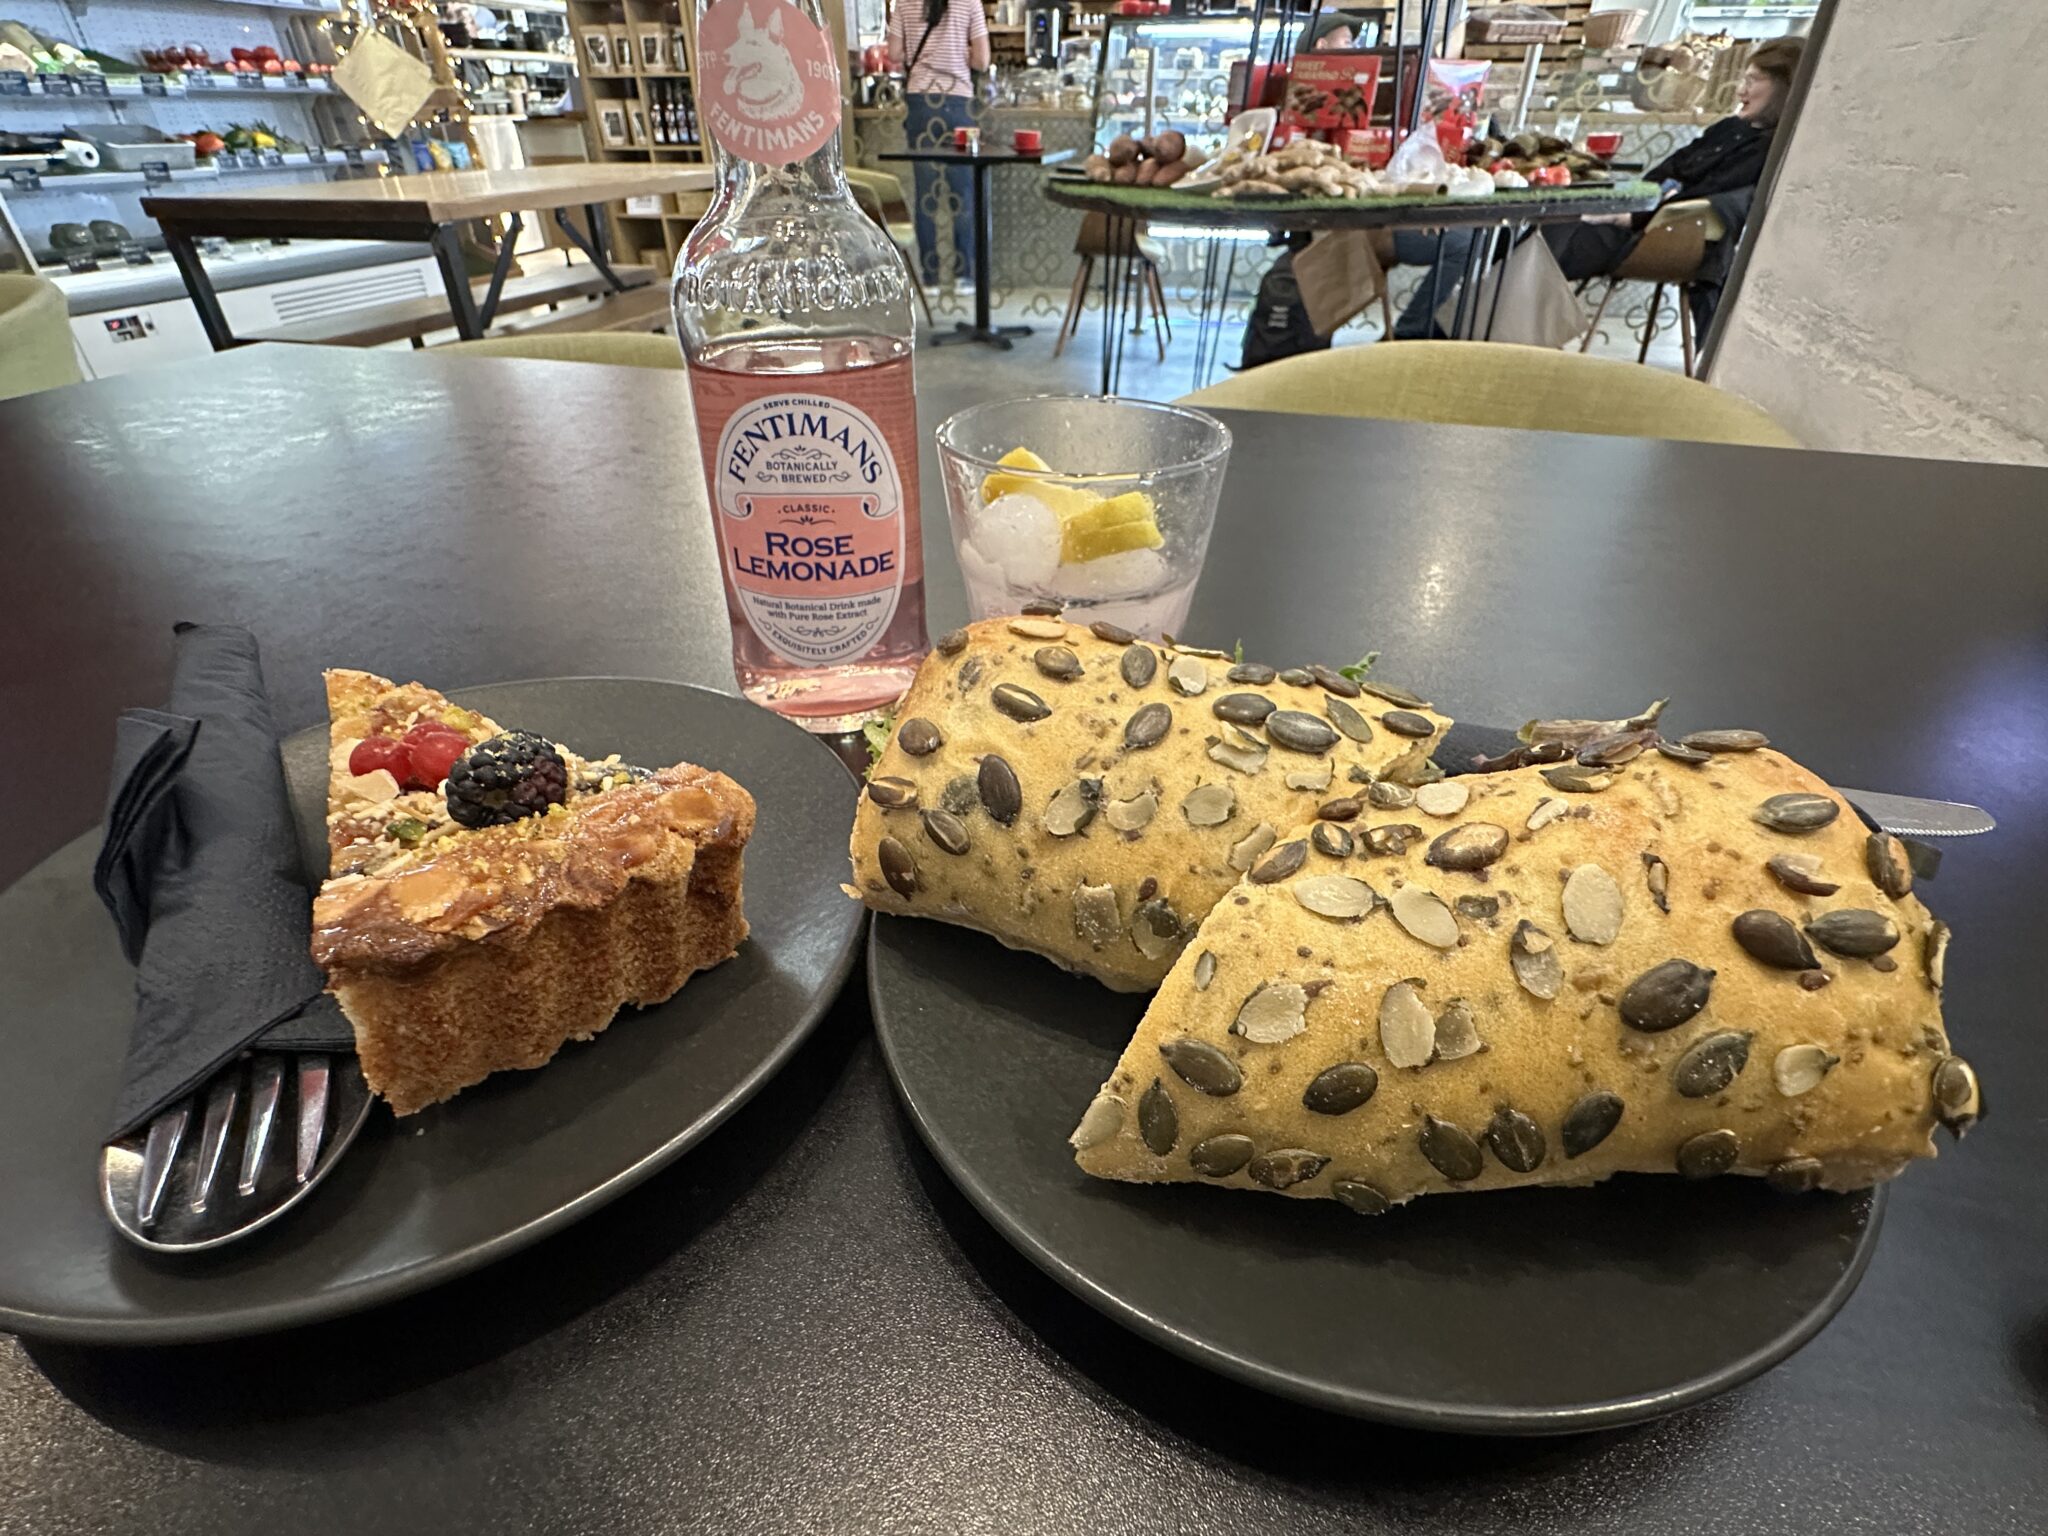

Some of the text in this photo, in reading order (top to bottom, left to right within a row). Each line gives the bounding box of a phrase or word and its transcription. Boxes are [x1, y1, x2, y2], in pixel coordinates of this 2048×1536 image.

[708, 101, 825, 151] FENTIMANS
[763, 398, 830, 410] SERVE CHILLED
[728, 412, 883, 485] FENTIMANS
[766, 460, 839, 472] BOTANICALLY
[781, 473, 827, 483] BREWED
[782, 504, 830, 514] CLASSIC
[765, 532, 854, 557] ROSE
[733, 547, 894, 581] LEMONADE
[753, 595, 881, 611] Natural Botanical Drink made
[767, 608, 867, 621] with Pure Rose Extract
[772, 630, 867, 656] EXQUISITELY CRAFTED
